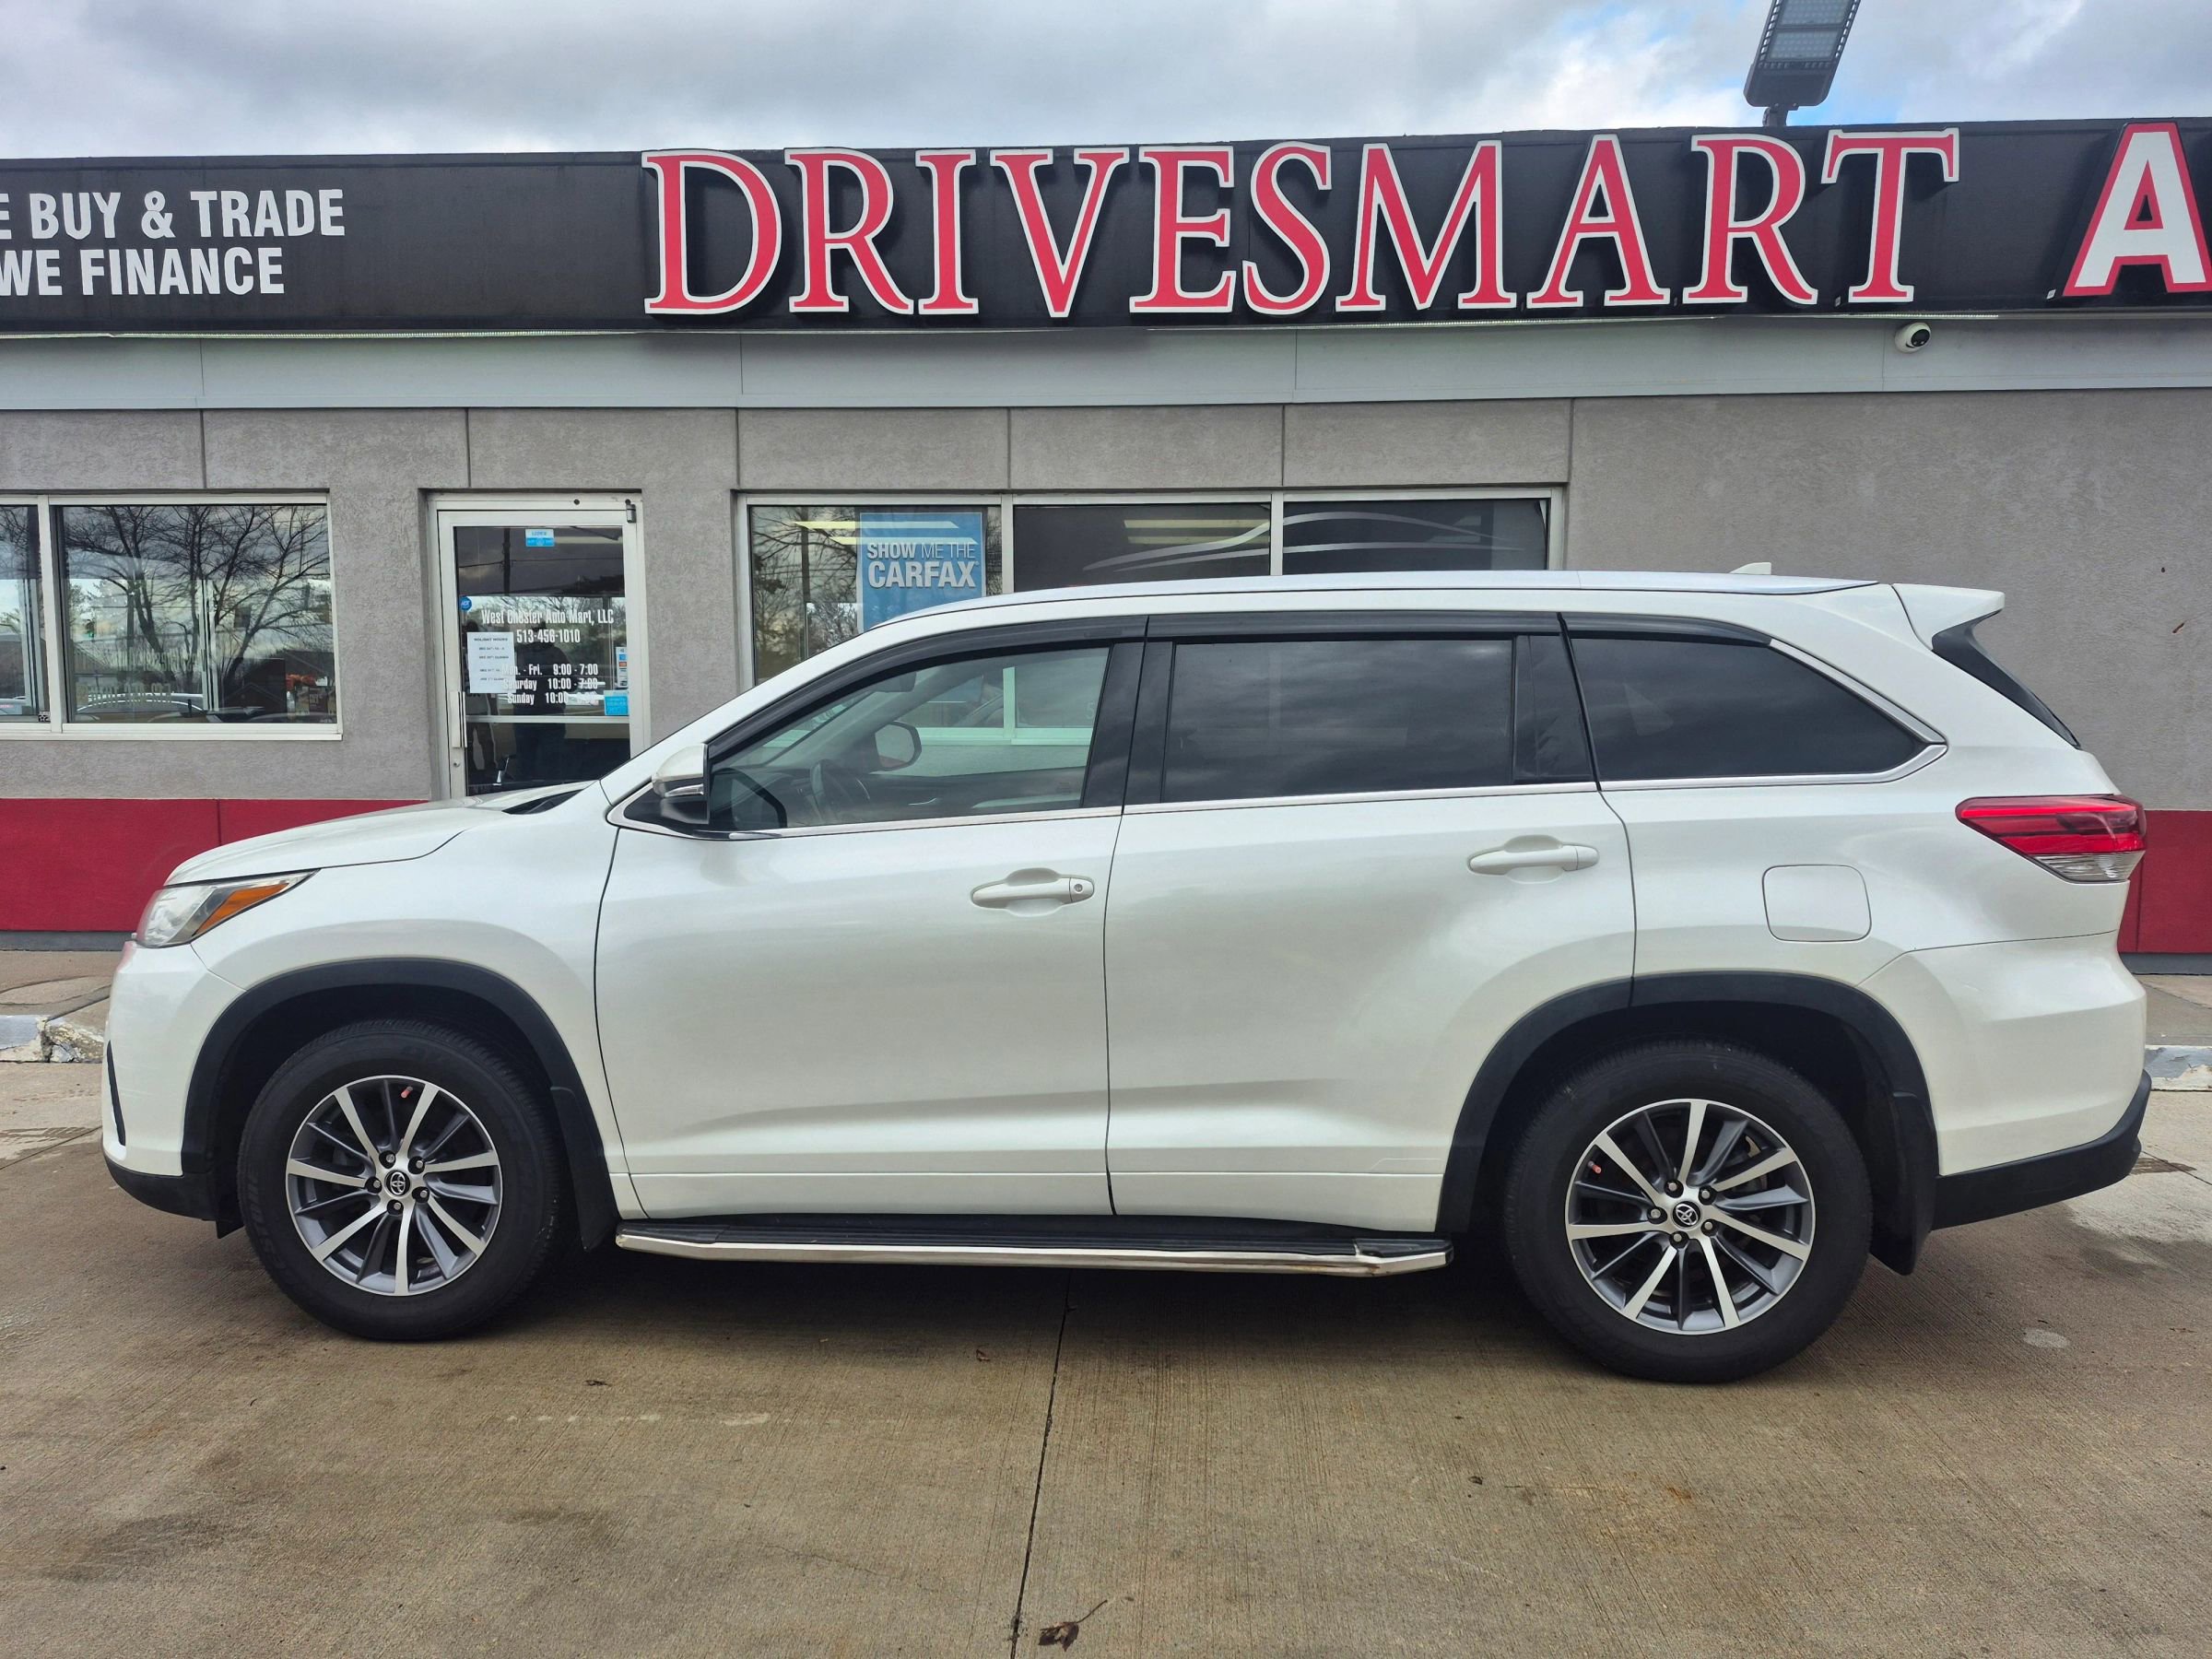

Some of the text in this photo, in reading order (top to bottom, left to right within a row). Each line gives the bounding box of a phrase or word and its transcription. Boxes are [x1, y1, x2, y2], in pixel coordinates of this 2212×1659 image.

[29, 192, 122, 240] BUY
[141, 190, 176, 239] &
[190, 189, 346, 239] TRADE
[640, 122, 2212, 319] DRIVESMART A
[0, 247, 285, 296] WE FINANCE
[866, 542, 976, 559] SHOW ME THE
[867, 560, 976, 588] CARFAX
[481, 609, 504, 625] West
[507, 609, 543, 624] Chester
[546, 609, 566, 624] Auto
[597, 608, 615, 624] LLC
[516, 629, 581, 643] 513-456-1010
[528, 664, 543, 676] Fri.
[553, 664, 571, 676] 9:00
[579, 664, 599, 676] 7:00
[547, 677, 571, 689] 10:00
[507, 691, 535, 705] Sunday
